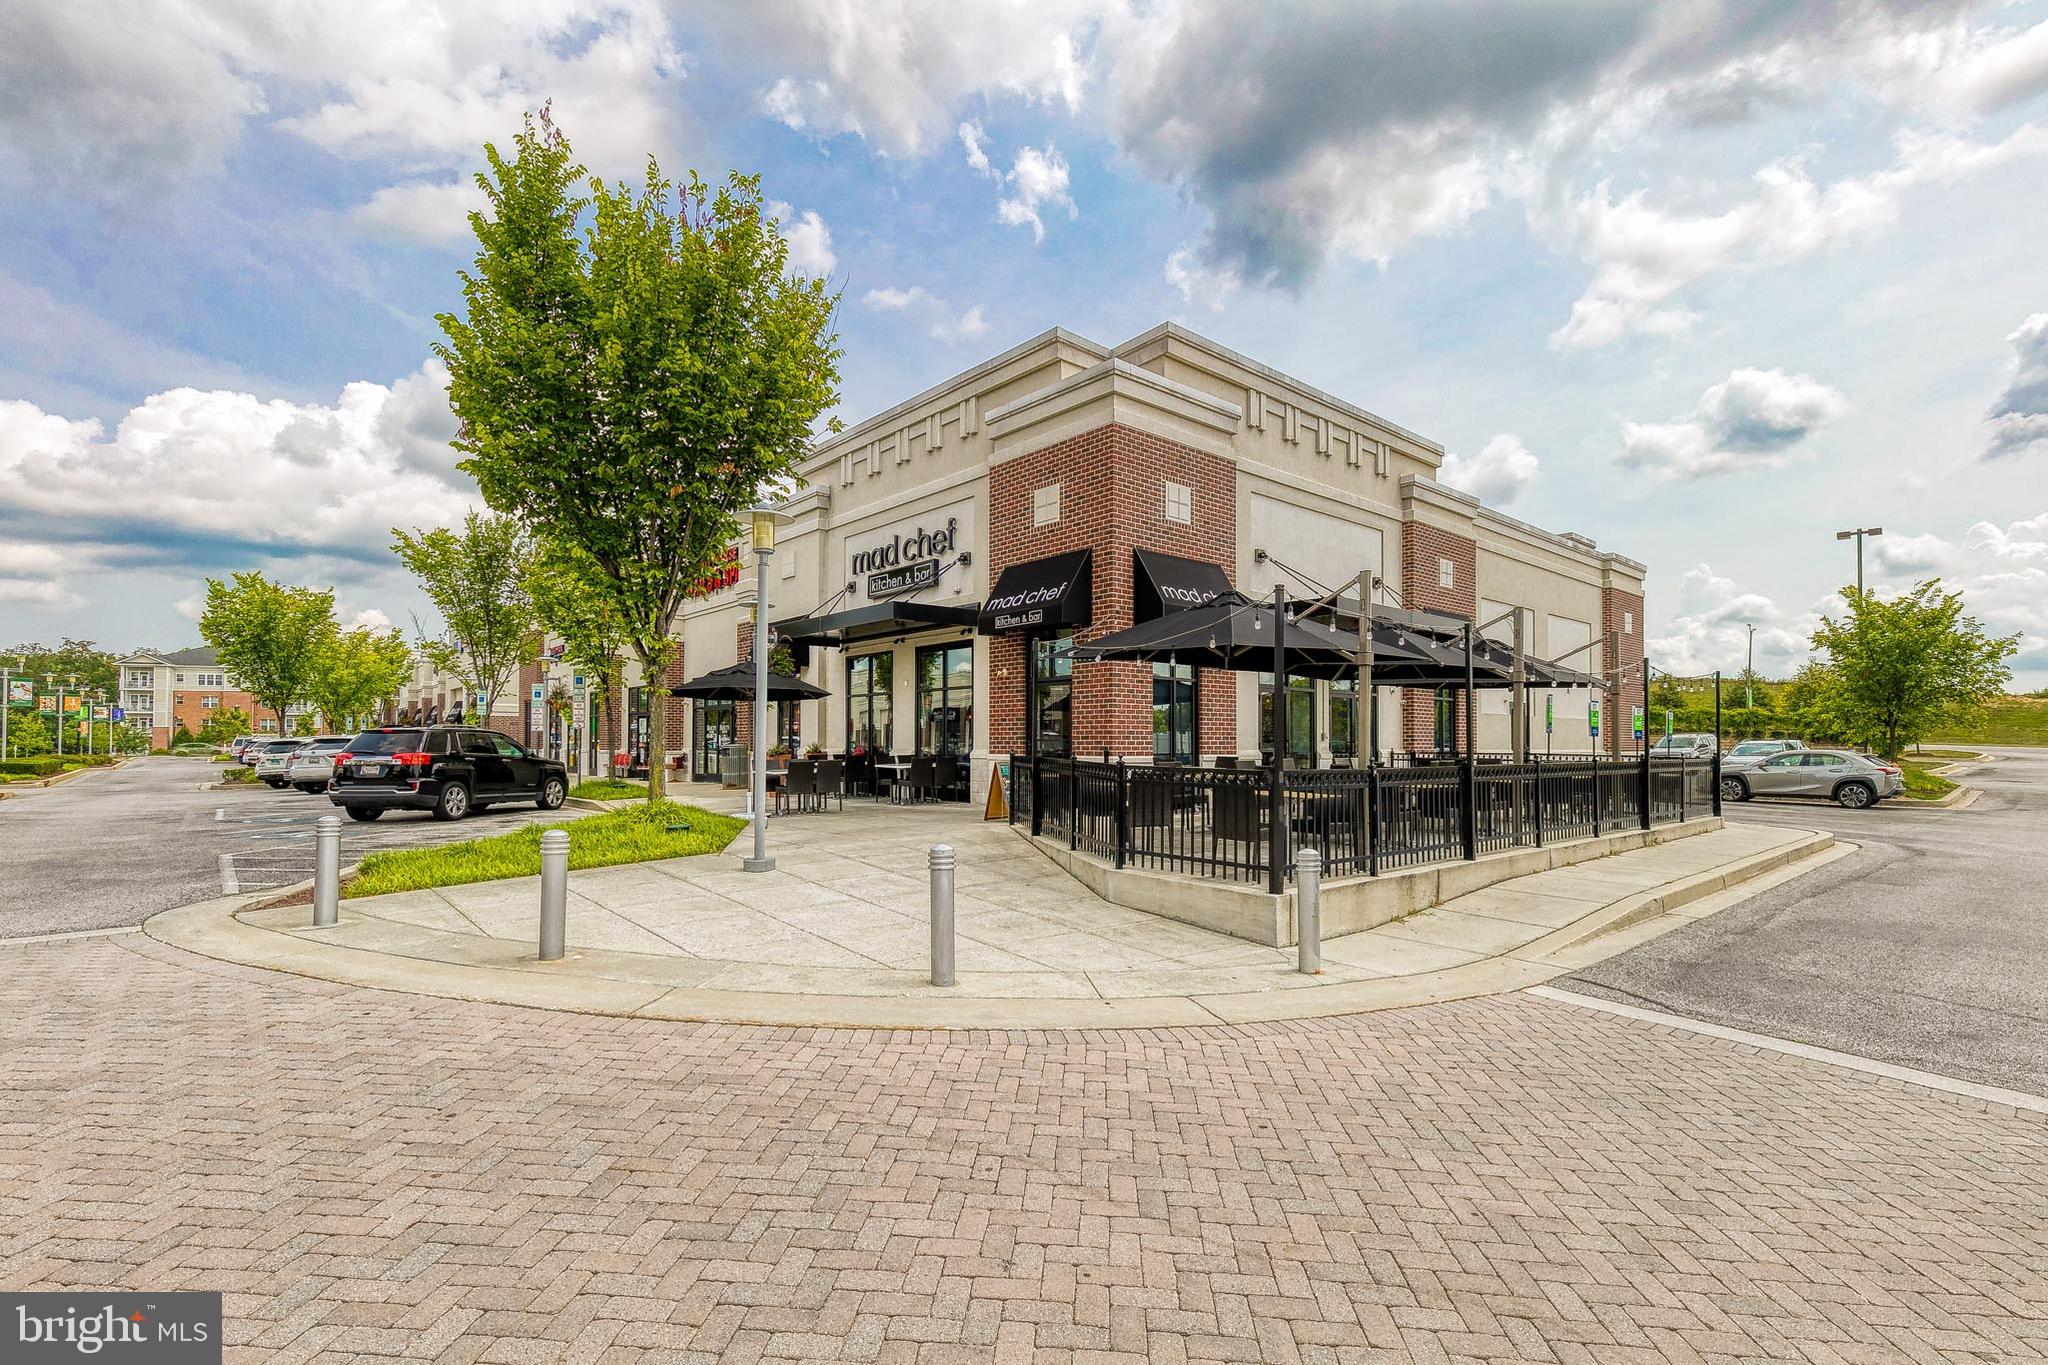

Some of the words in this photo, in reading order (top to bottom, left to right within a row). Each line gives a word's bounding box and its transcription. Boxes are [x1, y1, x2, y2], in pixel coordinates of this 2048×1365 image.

[852, 534, 900, 575] mad
[902, 517, 957, 561] chef
[871, 574, 903, 591] kitchen
[905, 572, 913, 585] &
[914, 563, 931, 583] bar
[987, 590, 1027, 612] mad
[1026, 581, 1068, 604] chef
[1161, 585, 1203, 604] mad
[995, 615, 1020, 628] kitchen
[1028, 610, 1042, 622] bar
